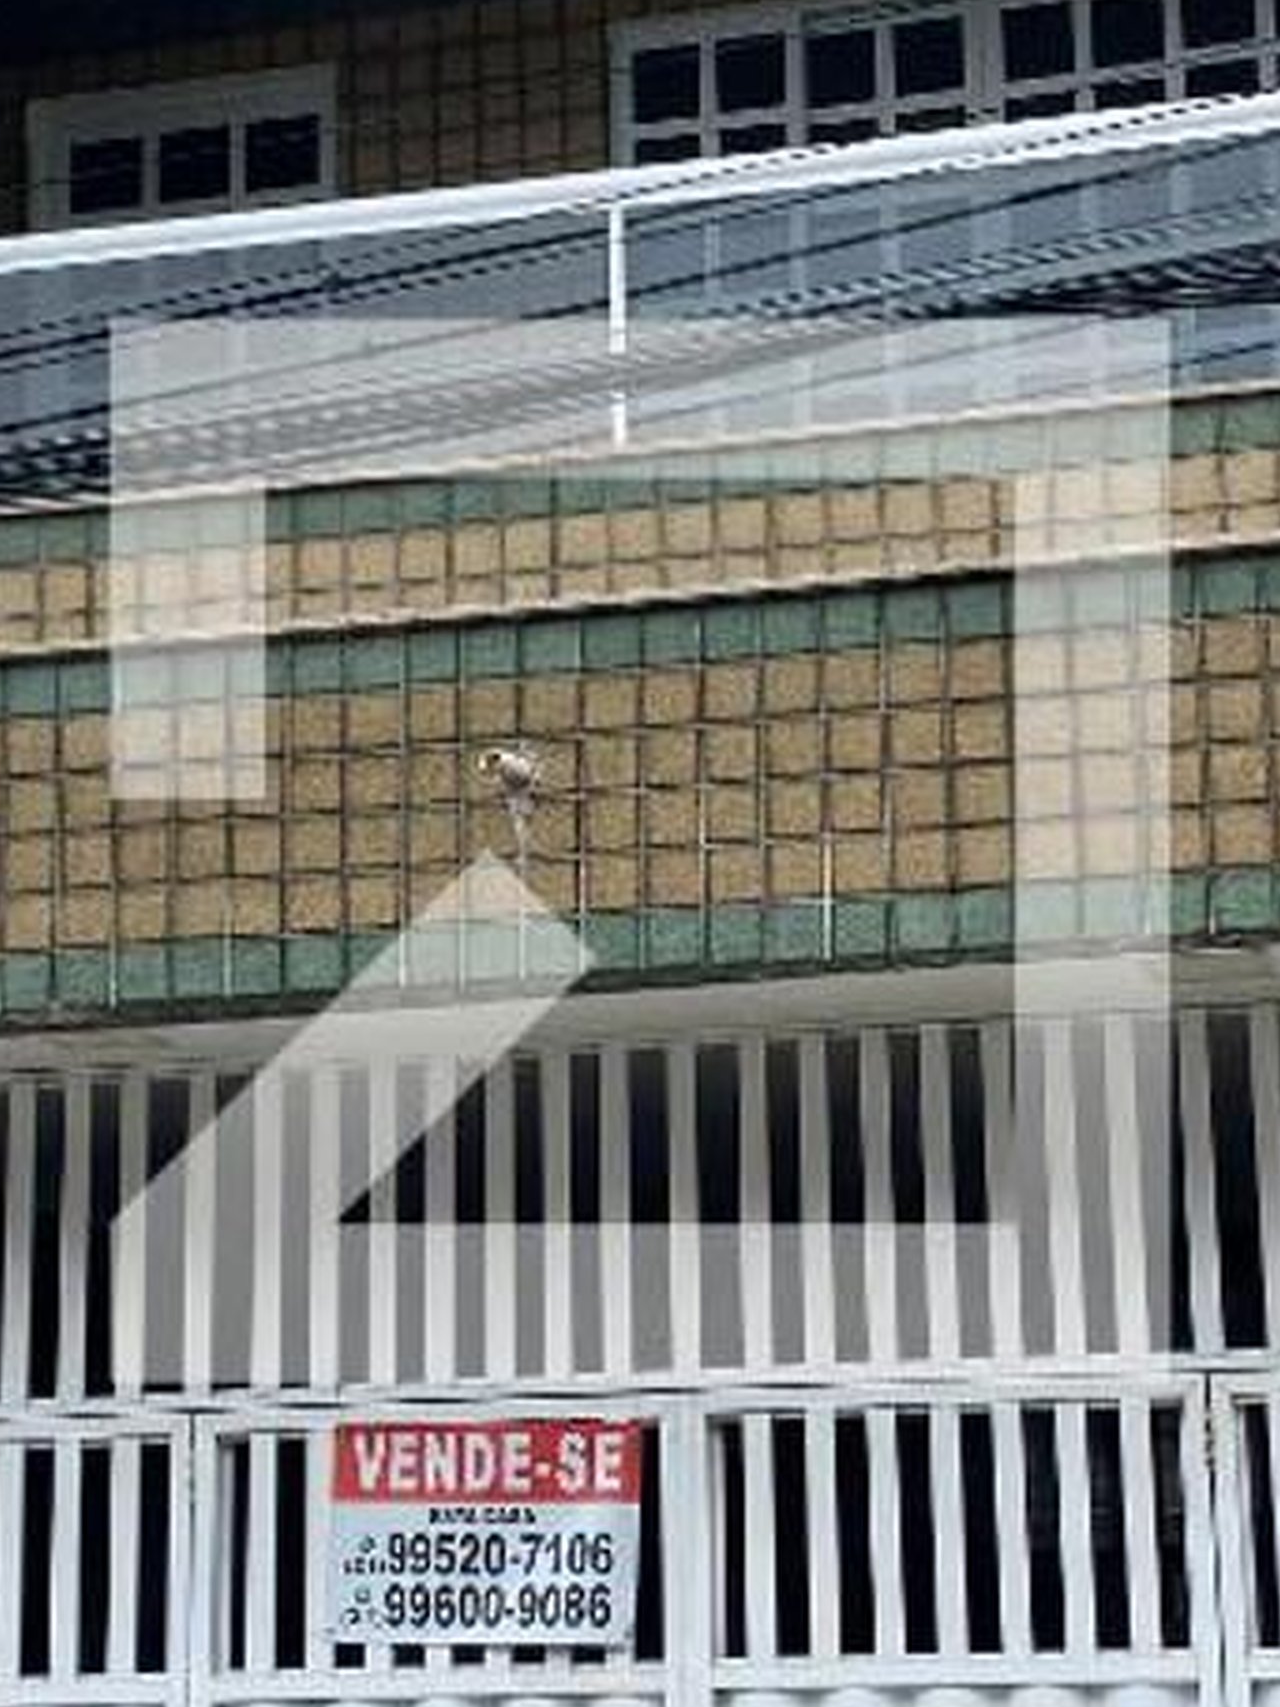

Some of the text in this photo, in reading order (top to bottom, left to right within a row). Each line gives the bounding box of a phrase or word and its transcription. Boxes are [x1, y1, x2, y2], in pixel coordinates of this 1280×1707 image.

[354, 1432, 622, 1492] VENDE-SE
[388, 1533, 614, 1575] 99520-7106
[384, 1583, 613, 1628] 99600-9086
